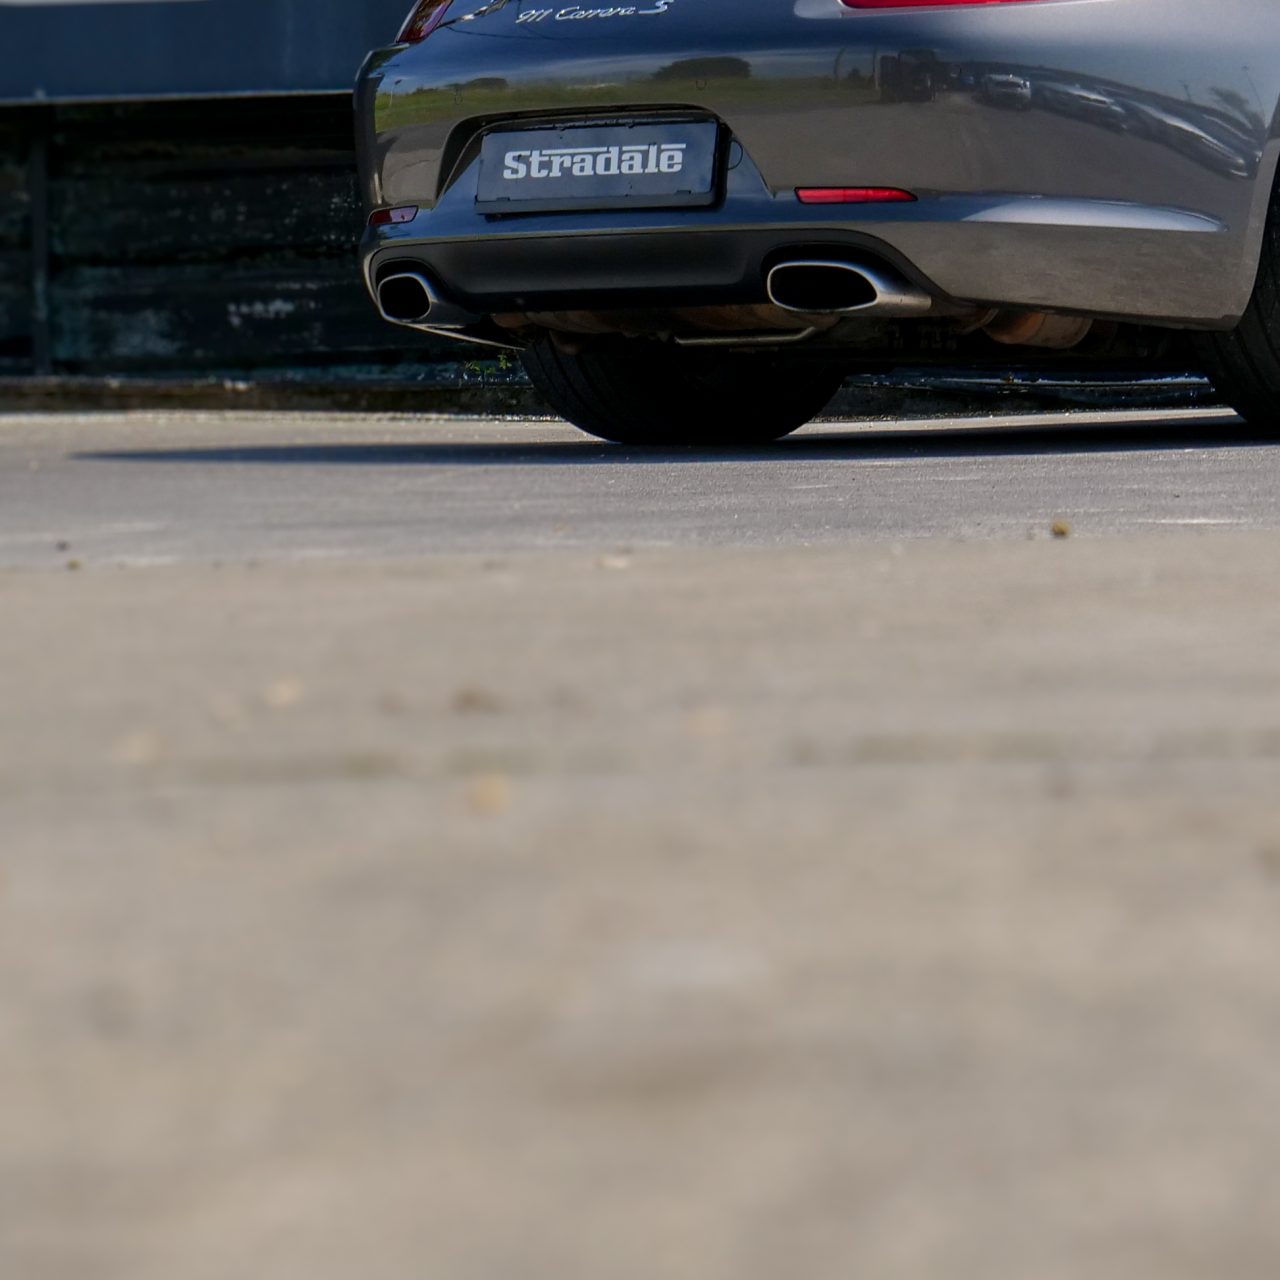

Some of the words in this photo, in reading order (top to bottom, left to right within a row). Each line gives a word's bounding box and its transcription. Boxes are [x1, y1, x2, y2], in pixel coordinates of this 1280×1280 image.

[516, 7, 553, 24] 911
[555, 5, 636, 22] Carrera
[503, 143, 687, 180] Stradale
